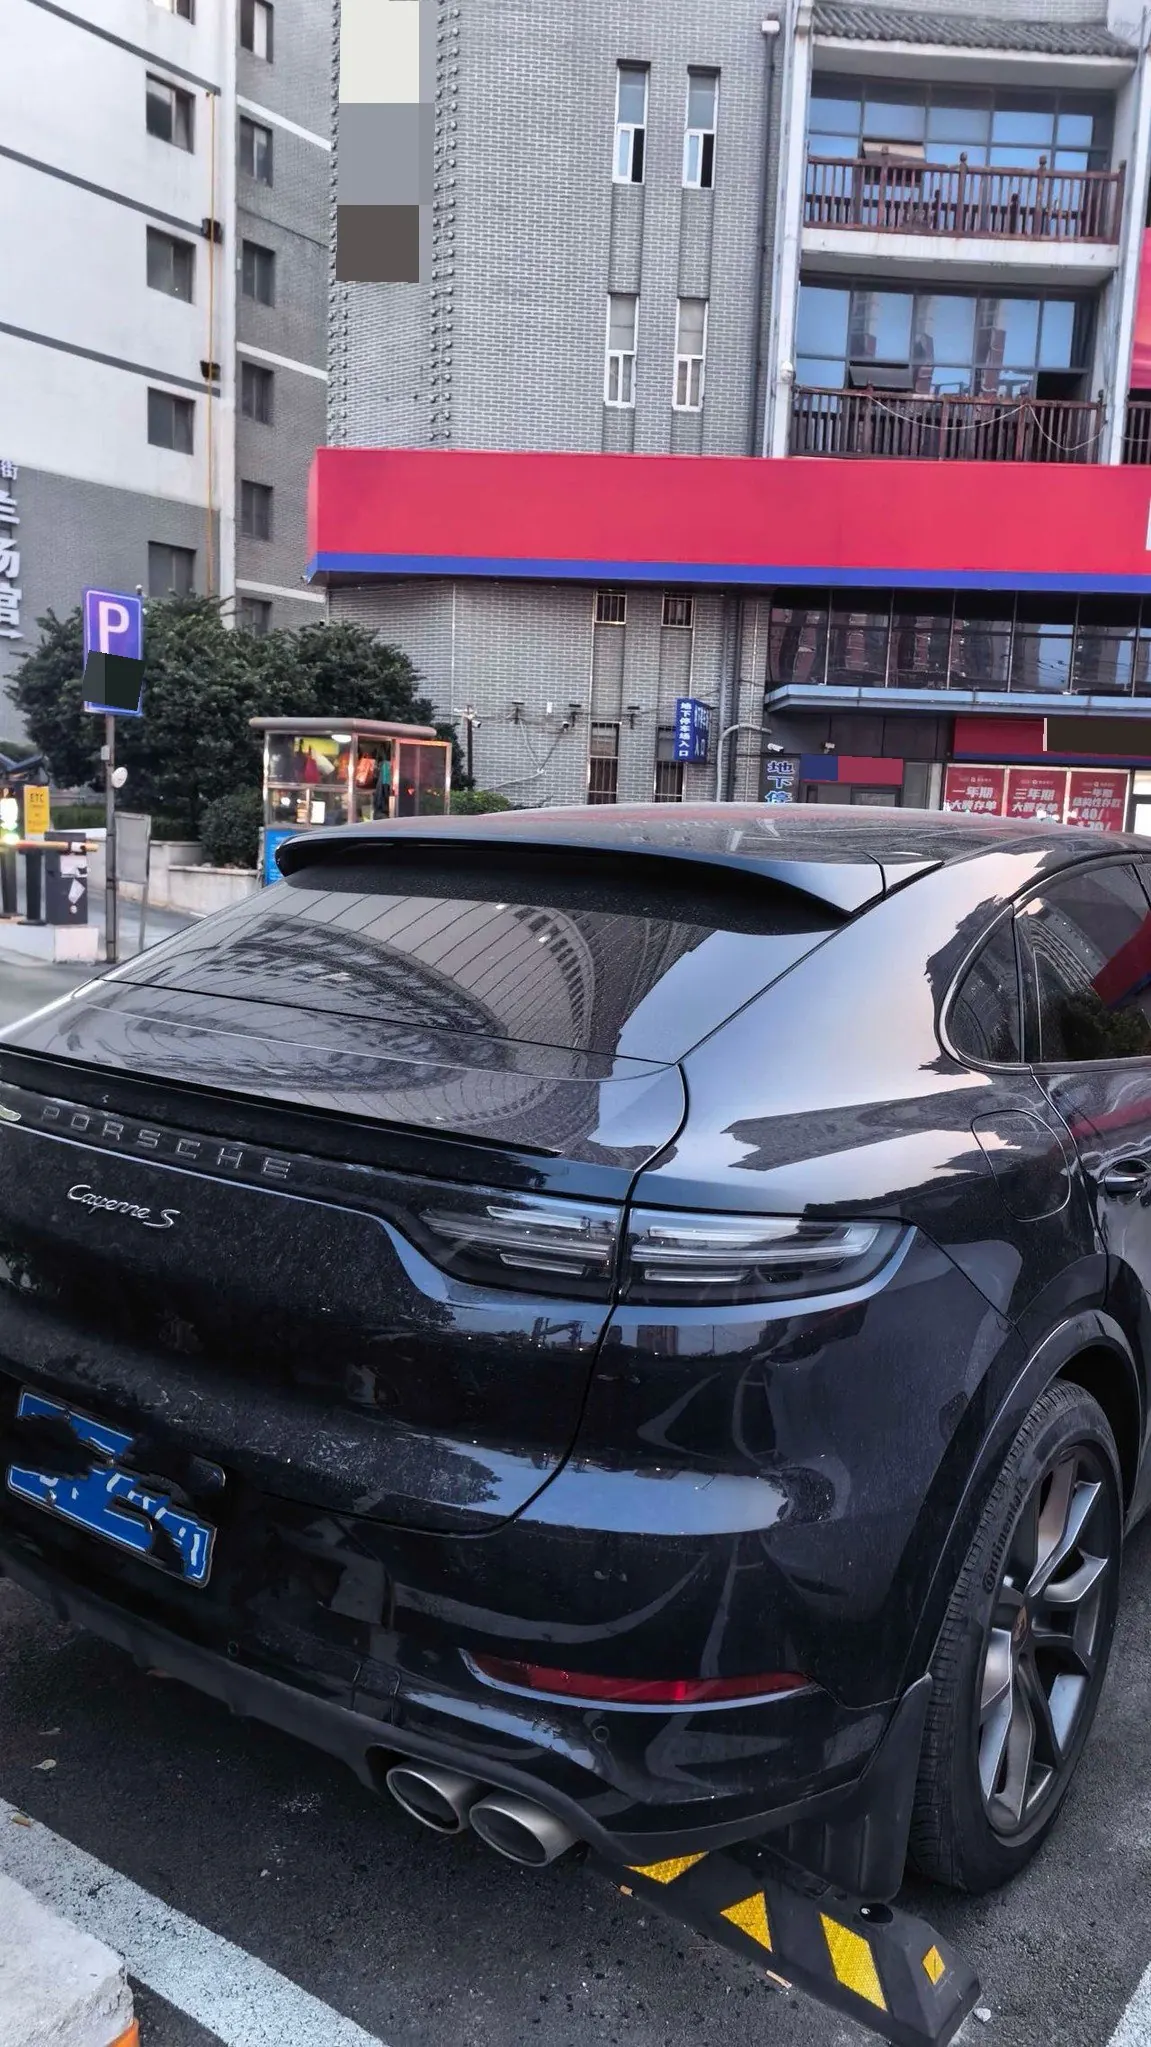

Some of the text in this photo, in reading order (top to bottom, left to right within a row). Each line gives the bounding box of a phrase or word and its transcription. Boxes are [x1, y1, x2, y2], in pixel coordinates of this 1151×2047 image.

[98, 600, 130, 654] P
[678, 702, 692, 757] 地下停车场入口
[40, 1106, 292, 1180] PORSCHE
[67, 1184, 181, 1228] Cayenne S
